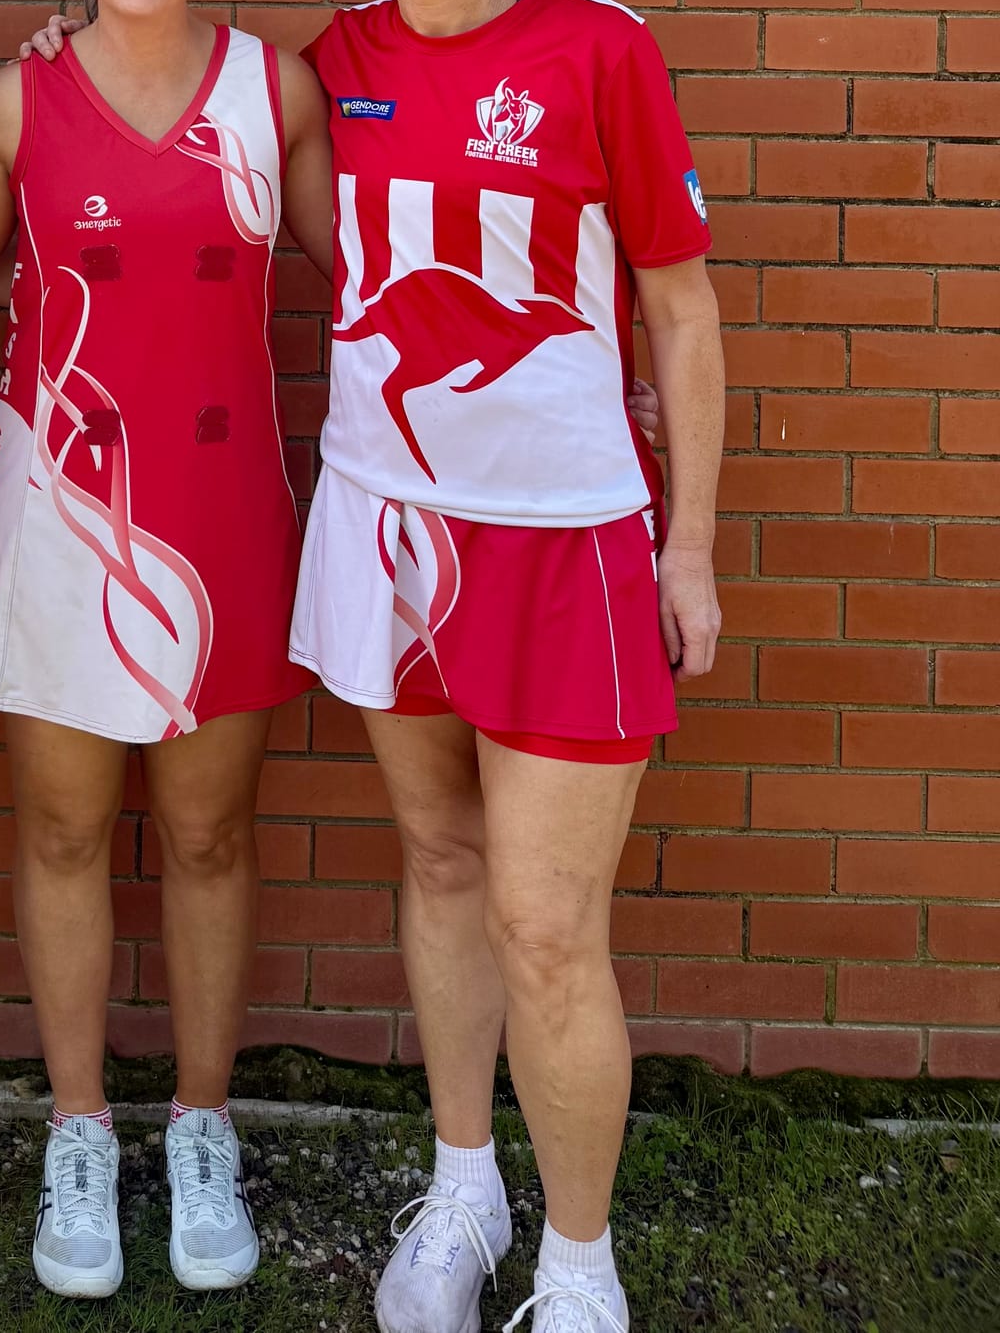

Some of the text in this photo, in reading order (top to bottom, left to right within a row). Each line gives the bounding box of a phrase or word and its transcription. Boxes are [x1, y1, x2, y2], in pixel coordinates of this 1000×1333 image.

[350, 100, 391, 113] GENDORE
[466, 138, 539, 161] FISH CREEK
[465, 150, 538, 168] FOOTBALL NETBALL CLUB
[73, 216, 122, 232] energetic
